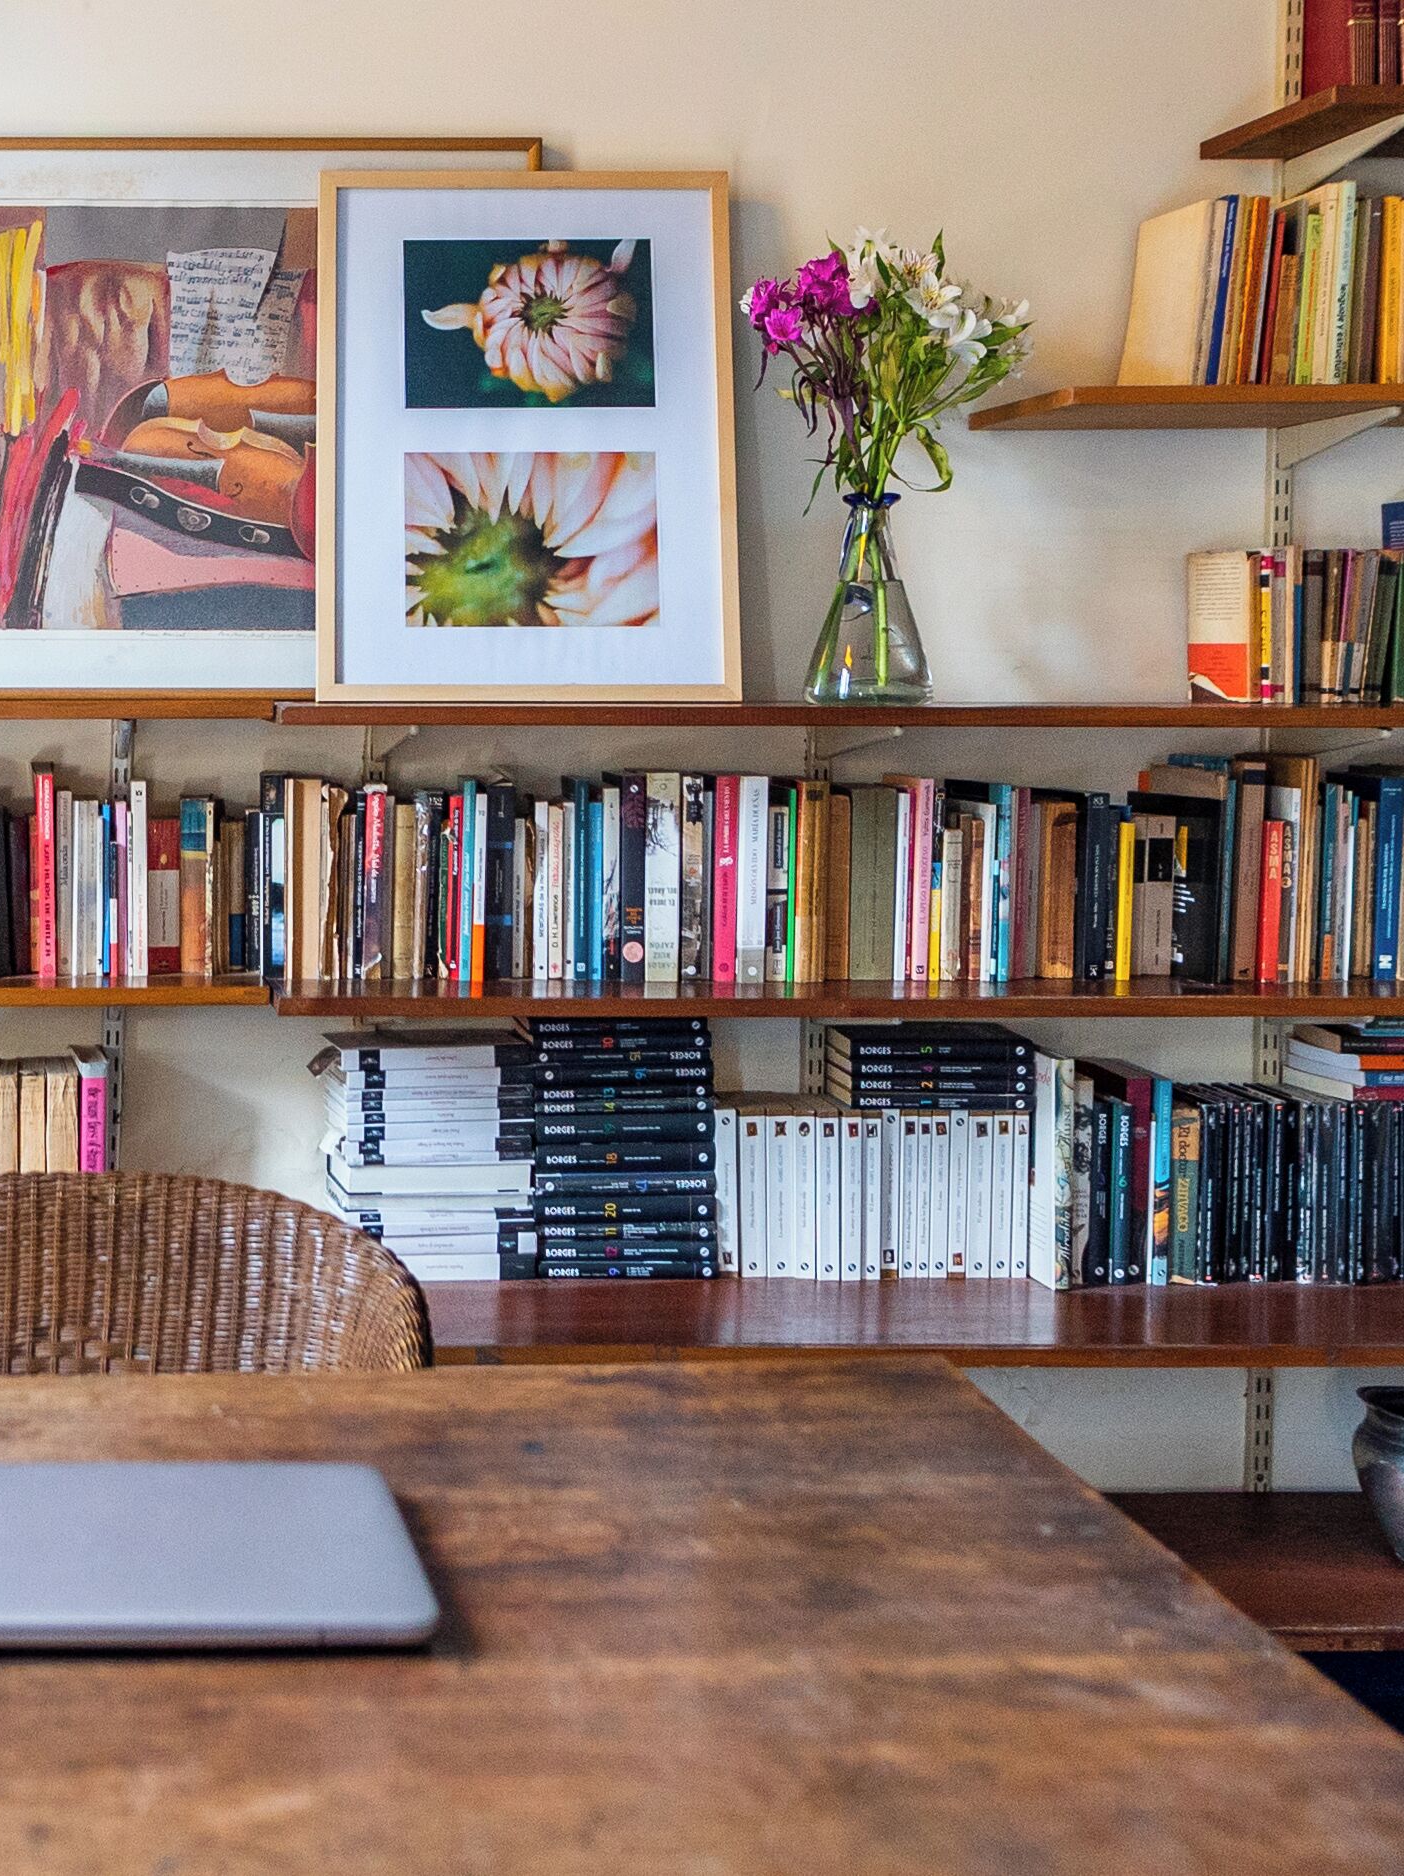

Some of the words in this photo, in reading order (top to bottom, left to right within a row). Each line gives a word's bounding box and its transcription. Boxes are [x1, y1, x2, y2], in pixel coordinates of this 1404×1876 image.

[1337, 283, 1349, 322] lenguaje
[751, 819, 760, 843] MARÍA
[653, 951, 671, 959] RUIZ
[543, 1041, 573, 1049] BORGES
[670, 1051, 700, 1059] BORGES
[860, 1081, 891, 1089] BORGES
[543, 1090, 574, 1099] BORGES
[860, 1098, 891, 1106] BORGES
[544, 1104, 575, 1112] BORGES
[1098, 1113, 1107, 1144] BORGES
[1120, 1115, 1129, 1146] BORGES
[1179, 1126, 1190, 1137] El
[546, 1155, 577, 1164] BORGES
[1179, 1140, 1191, 1176] doctor
[676, 1180, 706, 1188] BORGES
[545, 1206, 576, 1215] BORGES
[545, 1228, 575, 1237] BORGES
[545, 1248, 576, 1257] BORGES
[548, 1268, 579, 1277] BORGES
